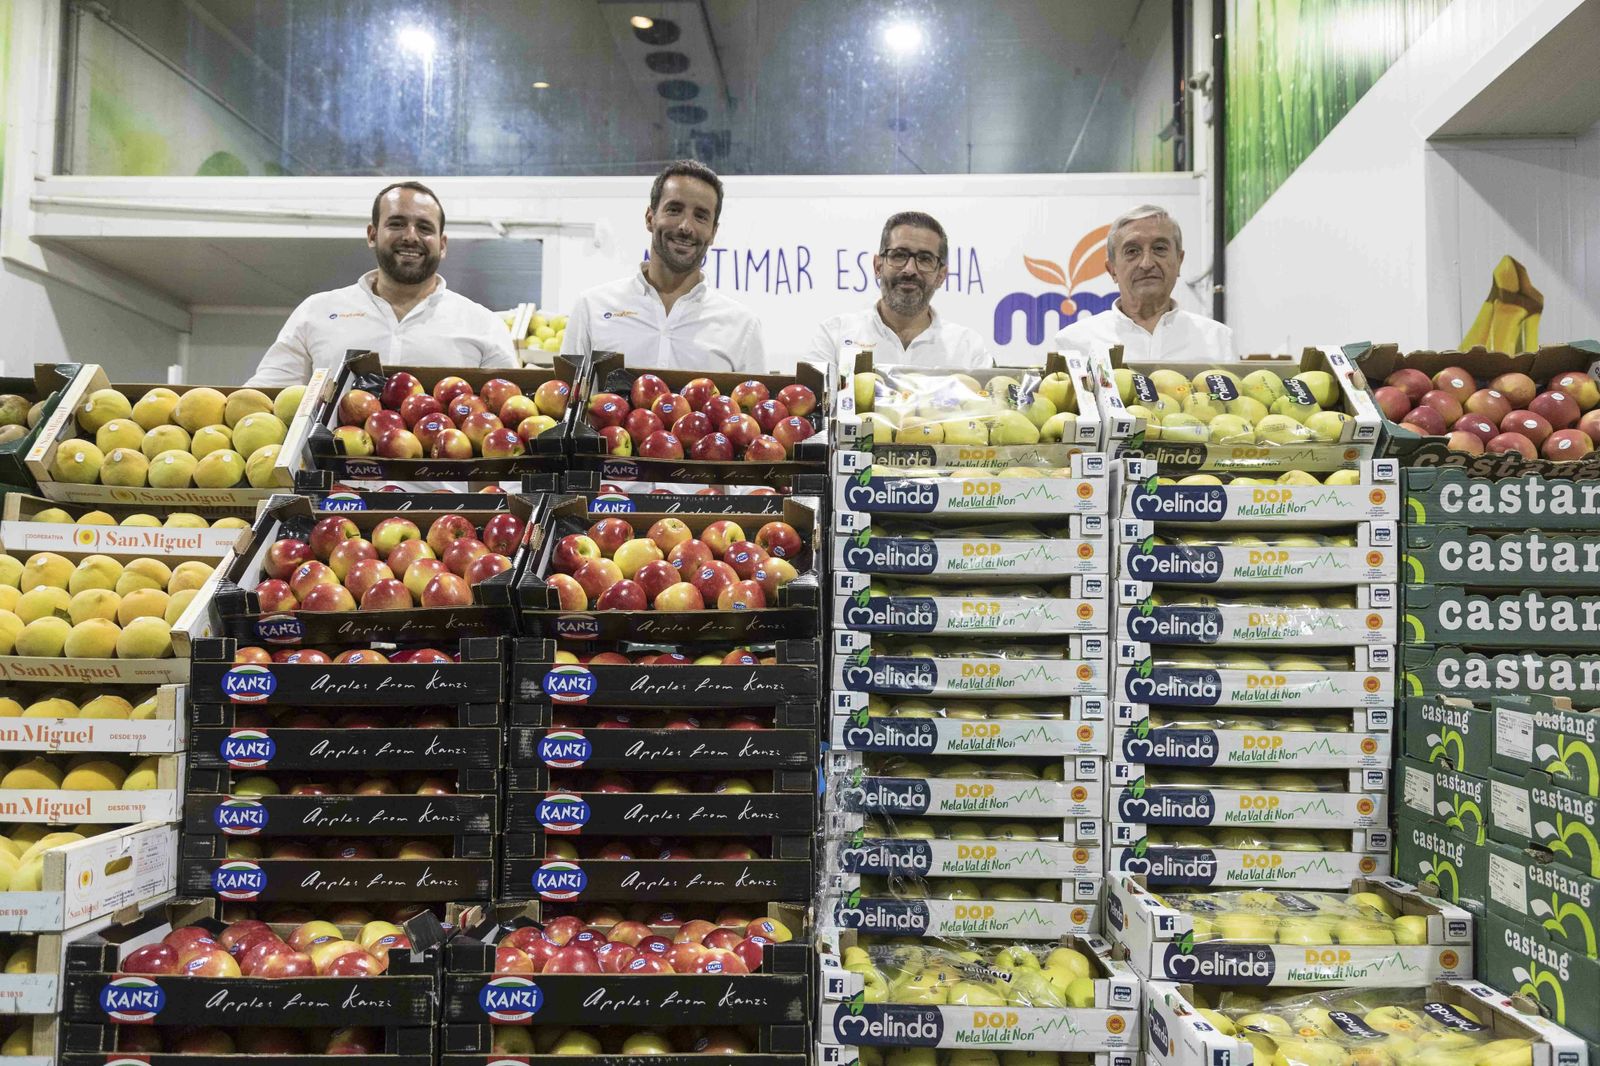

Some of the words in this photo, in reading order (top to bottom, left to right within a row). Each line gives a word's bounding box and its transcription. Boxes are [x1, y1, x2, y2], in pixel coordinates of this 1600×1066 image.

[873, 448, 933, 466] elinda
[850, 484, 933, 504] Melinda
[949, 497, 969, 508] Mela
[971, 495, 983, 507] Val
[986, 495, 995, 506] di
[997, 495, 1015, 506] Non
[1136, 491, 1221, 512] Melinda
[1238, 504, 1259, 516] Mela
[1261, 502, 1273, 515] Val
[1276, 502, 1285, 513] di
[1287, 501, 1306, 513] Non
[106, 531, 138, 547] San
[141, 532, 202, 554] Miguel
[848, 545, 932, 566] Melinda
[1132, 554, 1217, 574] Melinda
[1132, 617, 1217, 636] Melinda
[10, 663, 49, 677] San
[50, 664, 121, 683] Miguel
[311, 674, 366, 692] Apples
[376, 677, 415, 690] from
[426, 670, 467, 689] Kanzi
[631, 675, 685, 693] Apples
[695, 678, 733, 691] from
[743, 671, 784, 690] Kanzi
[848, 664, 932, 686] Melinda
[1130, 677, 1215, 698] Melinda
[1422, 705, 1469, 734] castang
[1536, 712, 1595, 742] castang
[22, 725, 94, 748] Miguel
[848, 724, 932, 746] Melinda
[947, 740, 968, 750] Mela
[970, 738, 983, 749] Val
[986, 738, 995, 748] di
[997, 738, 1016, 748] Non
[310, 740, 366, 758] Apples
[376, 742, 414, 756] from
[425, 736, 466, 755] Kanzi
[625, 741, 680, 759] Apples
[690, 744, 728, 757] from
[739, 737, 780, 757] Kanzi
[1127, 737, 1213, 757] Melinda
[1229, 751, 1250, 762] Mela
[1252, 749, 1265, 761] Val
[1267, 749, 1277, 760] di
[1279, 749, 1298, 759] Non
[1437, 772, 1481, 804] castang
[22, 797, 91, 820] Miguel
[303, 807, 359, 826] Apples
[369, 810, 407, 824] from
[419, 803, 460, 822] Kanzi
[624, 804, 679, 822] Apples
[689, 807, 727, 820] from
[738, 800, 779, 820] Kanzi
[1124, 798, 1209, 818] Melinda
[1532, 788, 1595, 825] castang
[1413, 830, 1463, 867] castang
[1125, 857, 1211, 876] Melinda
[1227, 870, 1248, 880] Mela
[1250, 868, 1263, 879] Val
[1266, 868, 1275, 878] di
[1277, 868, 1296, 878] Non
[301, 871, 357, 889] Apples
[367, 874, 405, 888] from
[417, 867, 458, 886] Kanzi
[621, 871, 676, 890] Apples
[686, 874, 724, 888] from
[736, 867, 776, 887] Kanzi
[1529, 864, 1592, 908] castang
[839, 906, 924, 928] Melinda
[940, 921, 961, 932] Mela
[963, 919, 975, 931] Val
[978, 919, 987, 930] di
[989, 919, 1008, 930] Non
[1170, 952, 1268, 976] Melinda
[1505, 929, 1569, 981] castang
[206, 989, 272, 1011] Apples
[283, 993, 329, 1009] from
[342, 985, 391, 1008] Kanzi
[583, 988, 649, 1010] Apples
[660, 991, 705, 1007] from
[719, 983, 767, 1006] Kanzi
[839, 1013, 936, 1039] Melinda
[956, 1031, 980, 1042] Mela
[982, 1029, 997, 1041] Val
[1000, 1028, 1010, 1040] di
[1013, 1028, 1034, 1039] Non
